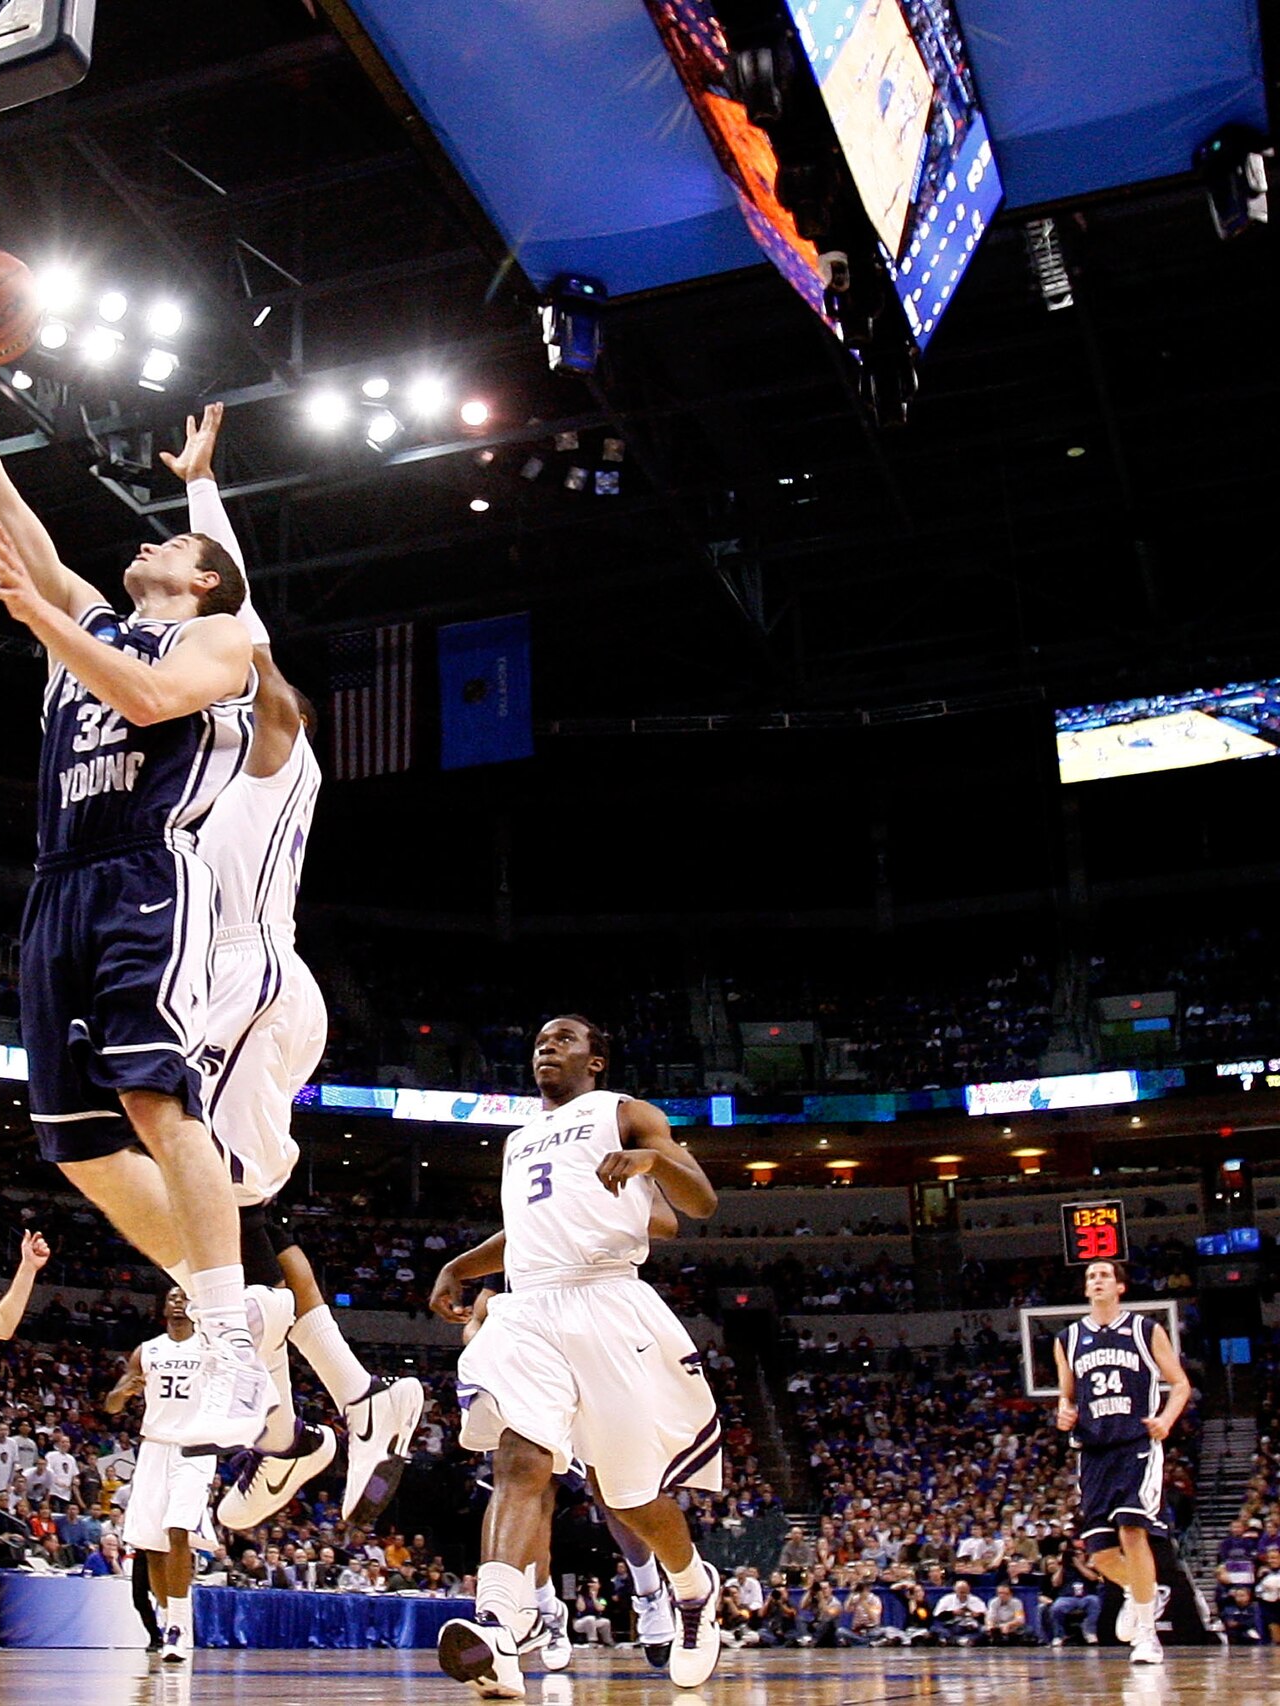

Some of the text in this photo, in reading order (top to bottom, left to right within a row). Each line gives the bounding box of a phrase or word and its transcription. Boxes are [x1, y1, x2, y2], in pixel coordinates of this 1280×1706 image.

[73, 703, 127, 752] 32
[59, 752, 145, 809] YOUNG
[527, 1162, 553, 1205] 3
[1073, 1208, 1119, 1228] 13:24
[1075, 1223, 1119, 1259] 33
[1074, 1348, 1140, 1380] BRIGHAM
[160, 1375, 192, 1400] 32
[1090, 1370, 1124, 1396] 34
[1088, 1396, 1132, 1420] YOUNG
